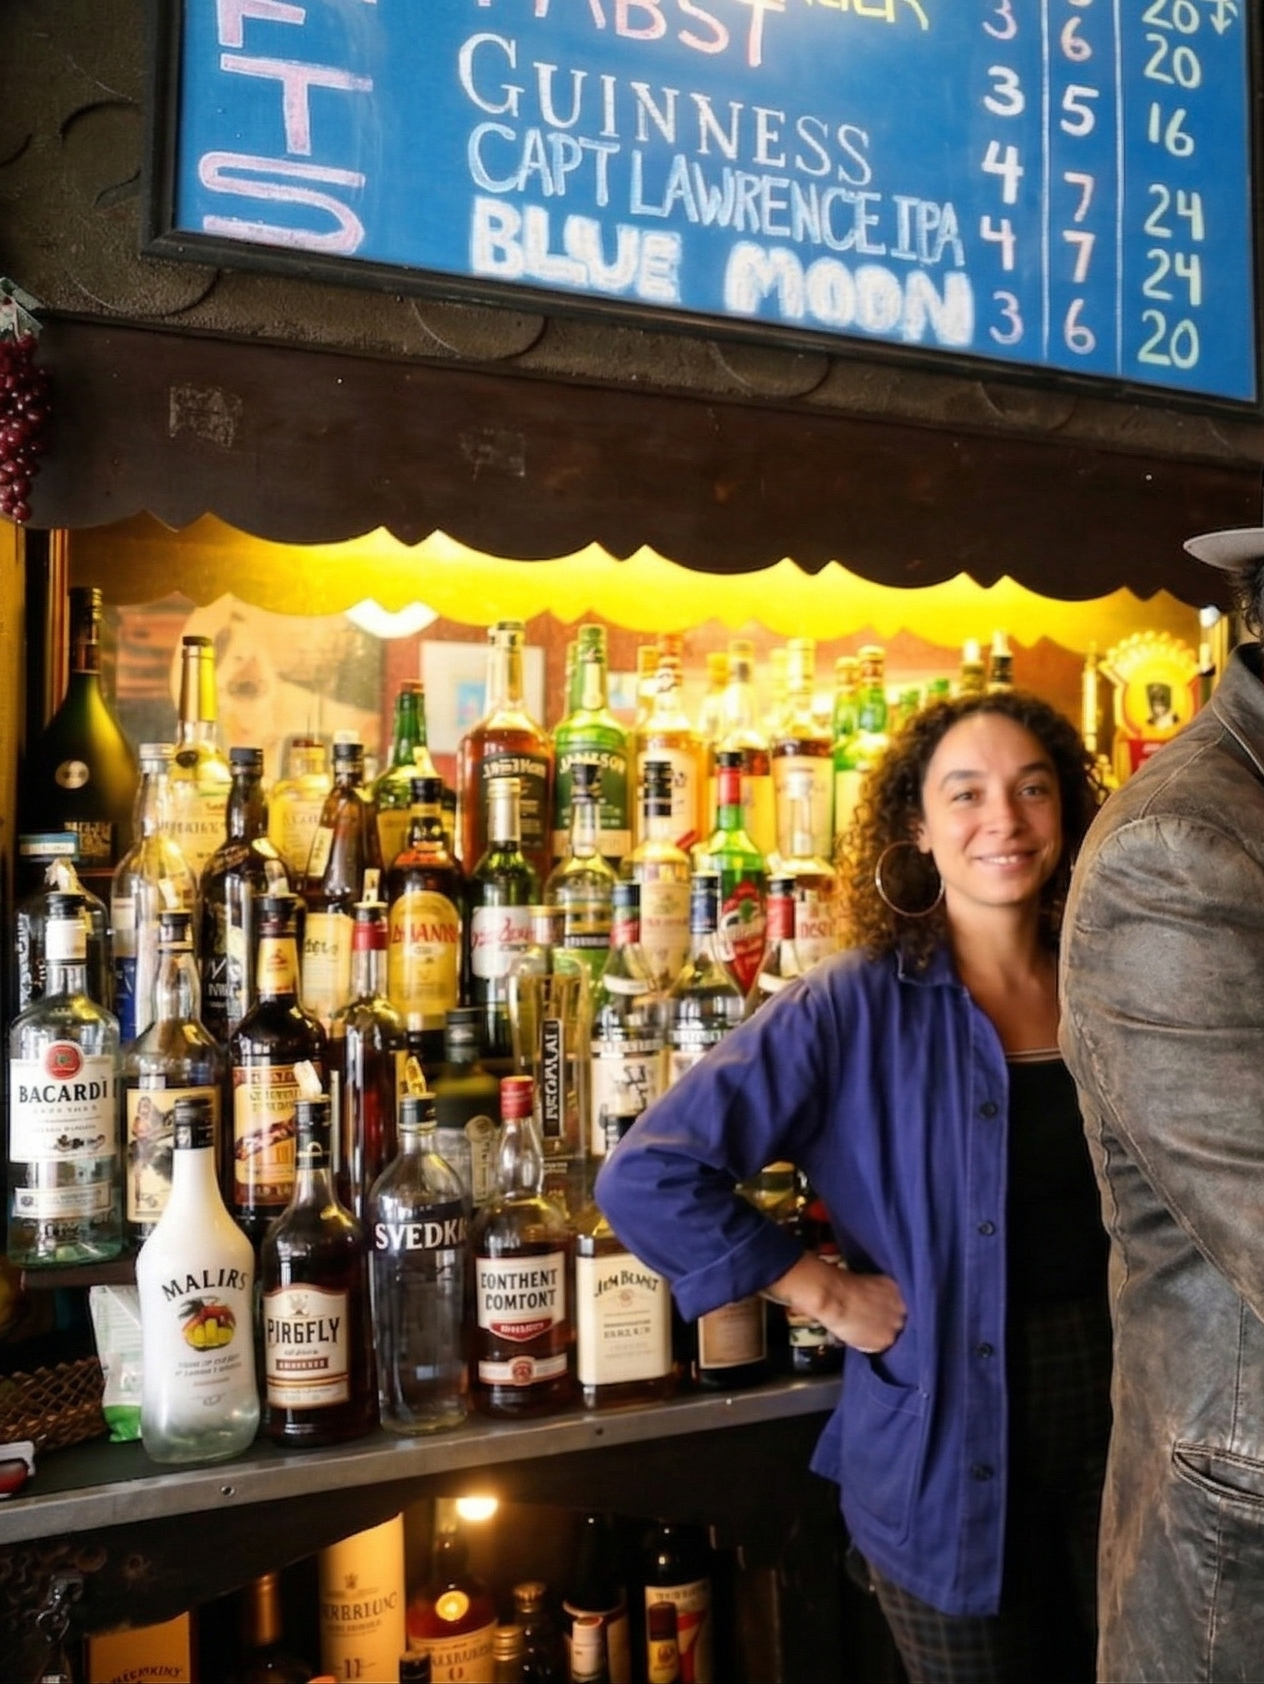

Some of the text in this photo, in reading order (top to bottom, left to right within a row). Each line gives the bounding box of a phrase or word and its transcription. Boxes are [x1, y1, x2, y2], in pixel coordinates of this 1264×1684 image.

[457, 32, 1205, 241] GUINNESS 4 7 24
[478, 0, 787, 66] BST
[984, 65, 1026, 117] 3
[1060, 84, 1100, 137] 5
[1148, 102, 1195, 157] 16
[1060, 16, 1093, 62] 6
[1146, 34, 1201, 89] 20
[466, 121, 621, 207] CAPT
[630, 149, 886, 255] LAWRENCE
[980, 215, 1016, 273] 4
[1062, 229, 1096, 284] 7
[1142, 248, 1202, 307] 24
[468, 196, 1200, 370] BLUE MOON 3 6 20
